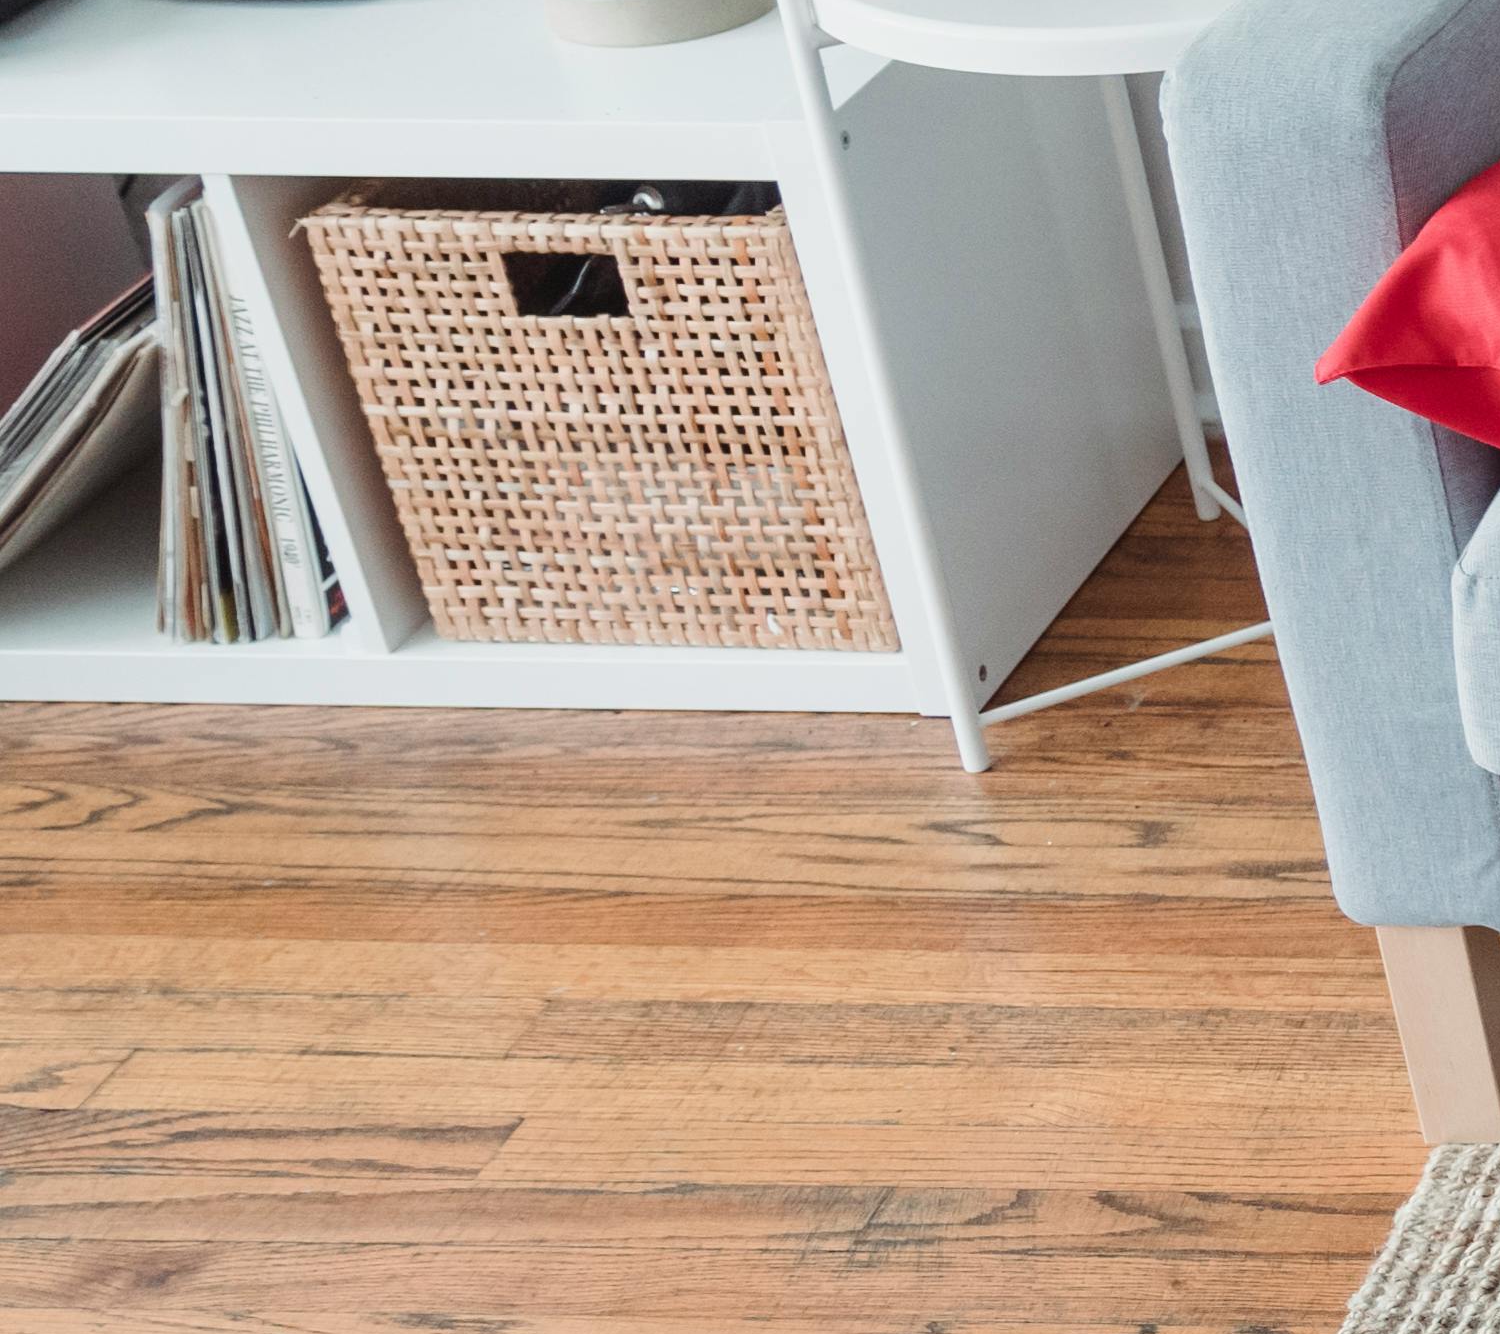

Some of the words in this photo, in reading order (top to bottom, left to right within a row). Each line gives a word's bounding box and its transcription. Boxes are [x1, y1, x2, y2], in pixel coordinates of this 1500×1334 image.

[228, 294, 256, 336] JAZZ
[238, 339, 260, 361] AT
[243, 365, 266, 396] THE
[250, 399, 293, 524] PHILHARMONIC
